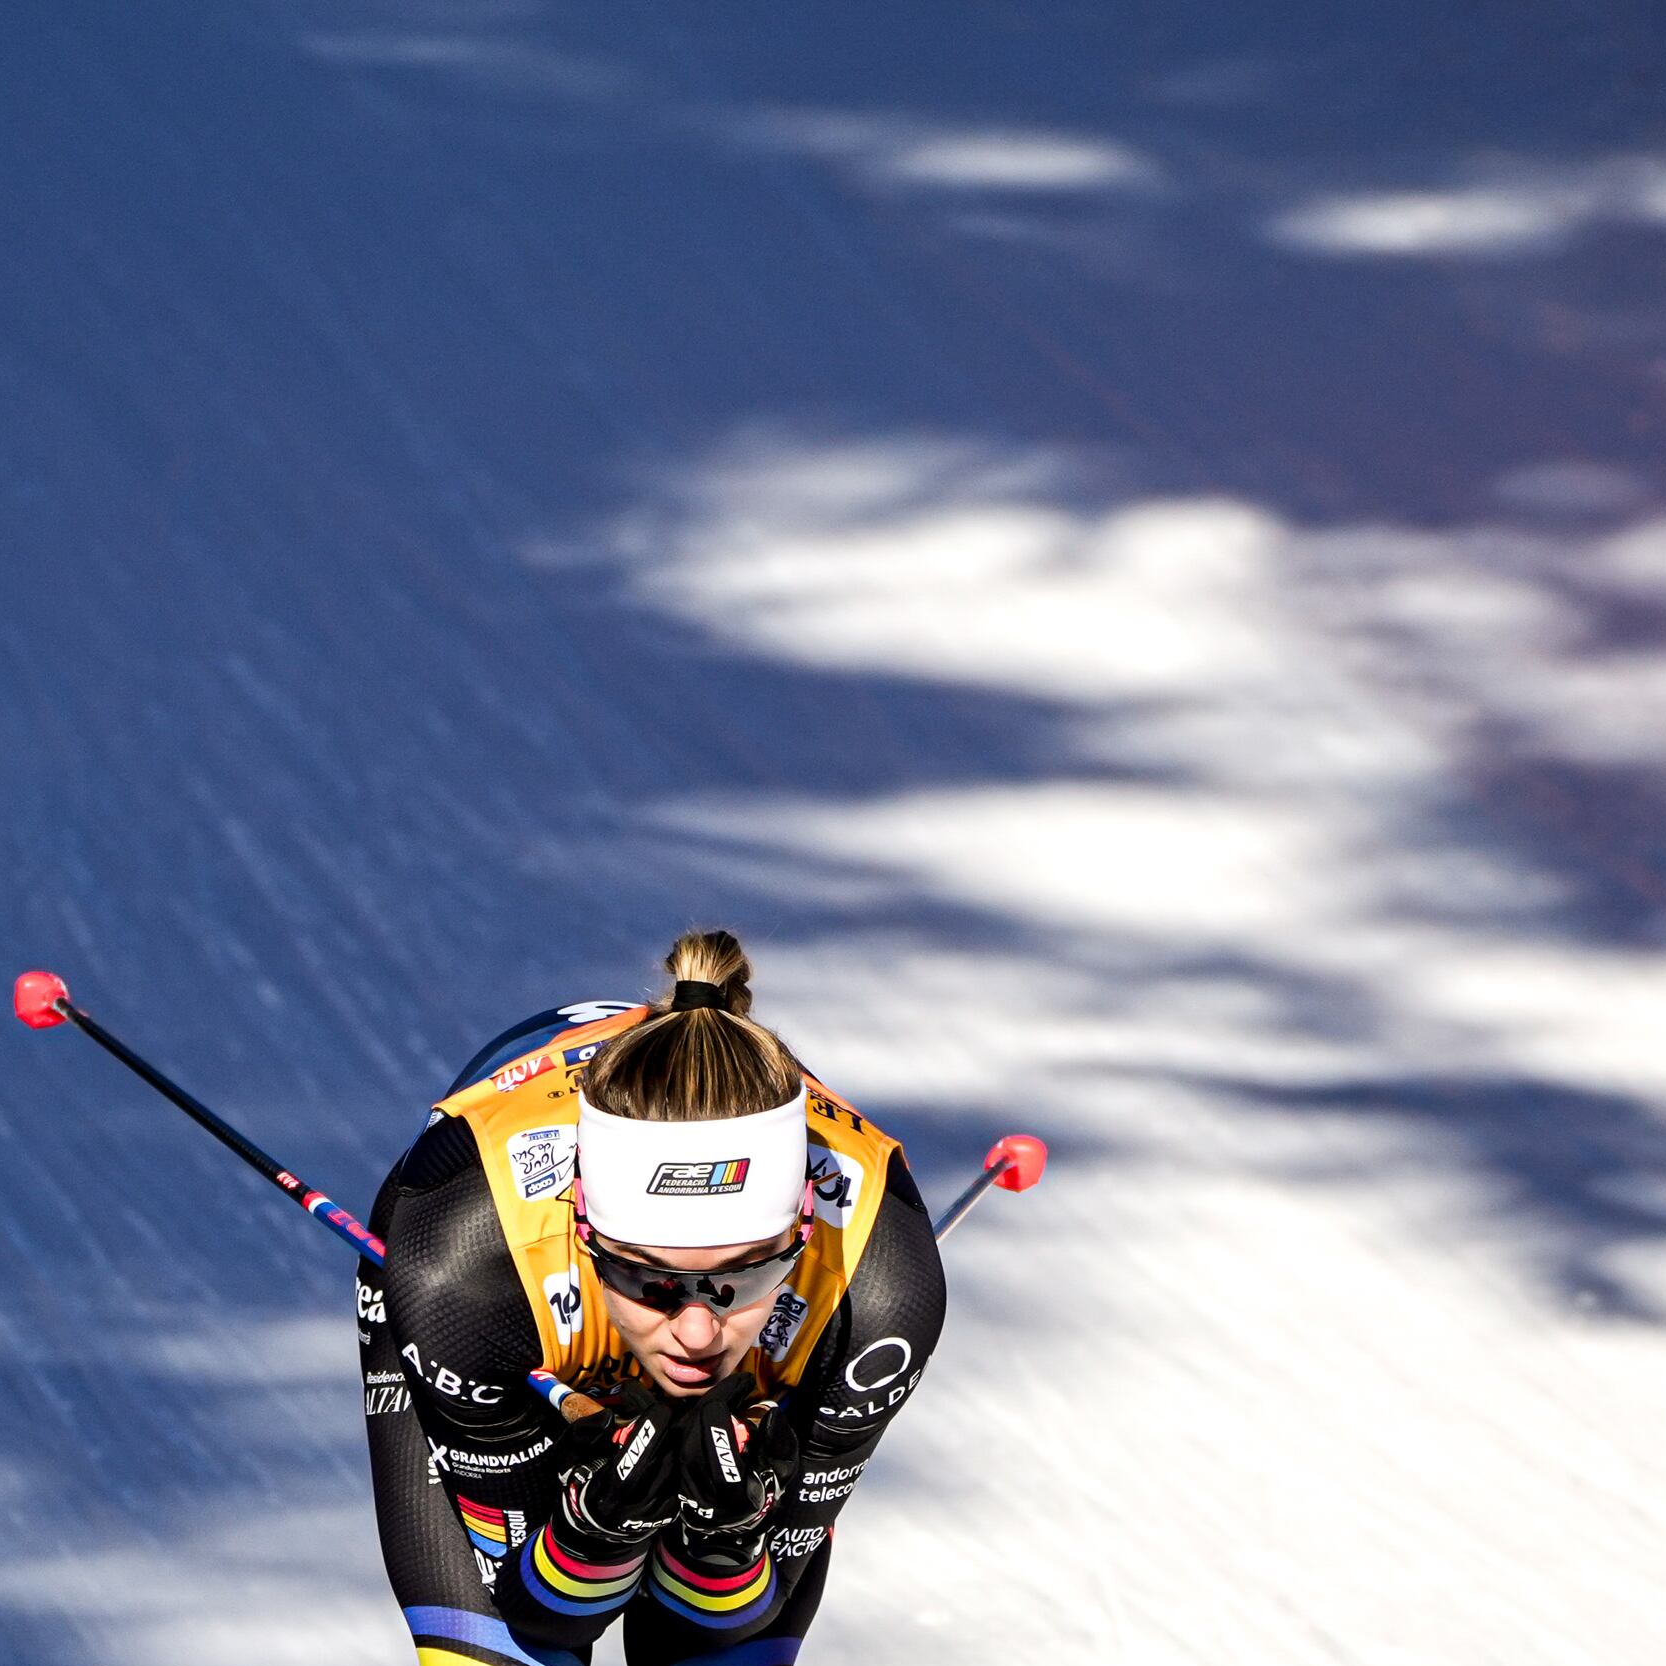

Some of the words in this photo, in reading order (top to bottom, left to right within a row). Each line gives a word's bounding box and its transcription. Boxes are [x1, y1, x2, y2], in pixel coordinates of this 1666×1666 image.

[449, 1436, 553, 1467] GRANDVALIRA
[618, 1425, 652, 1478] KV+
[713, 1429, 738, 1481] KV+
[774, 1526, 824, 1543] AUTO
